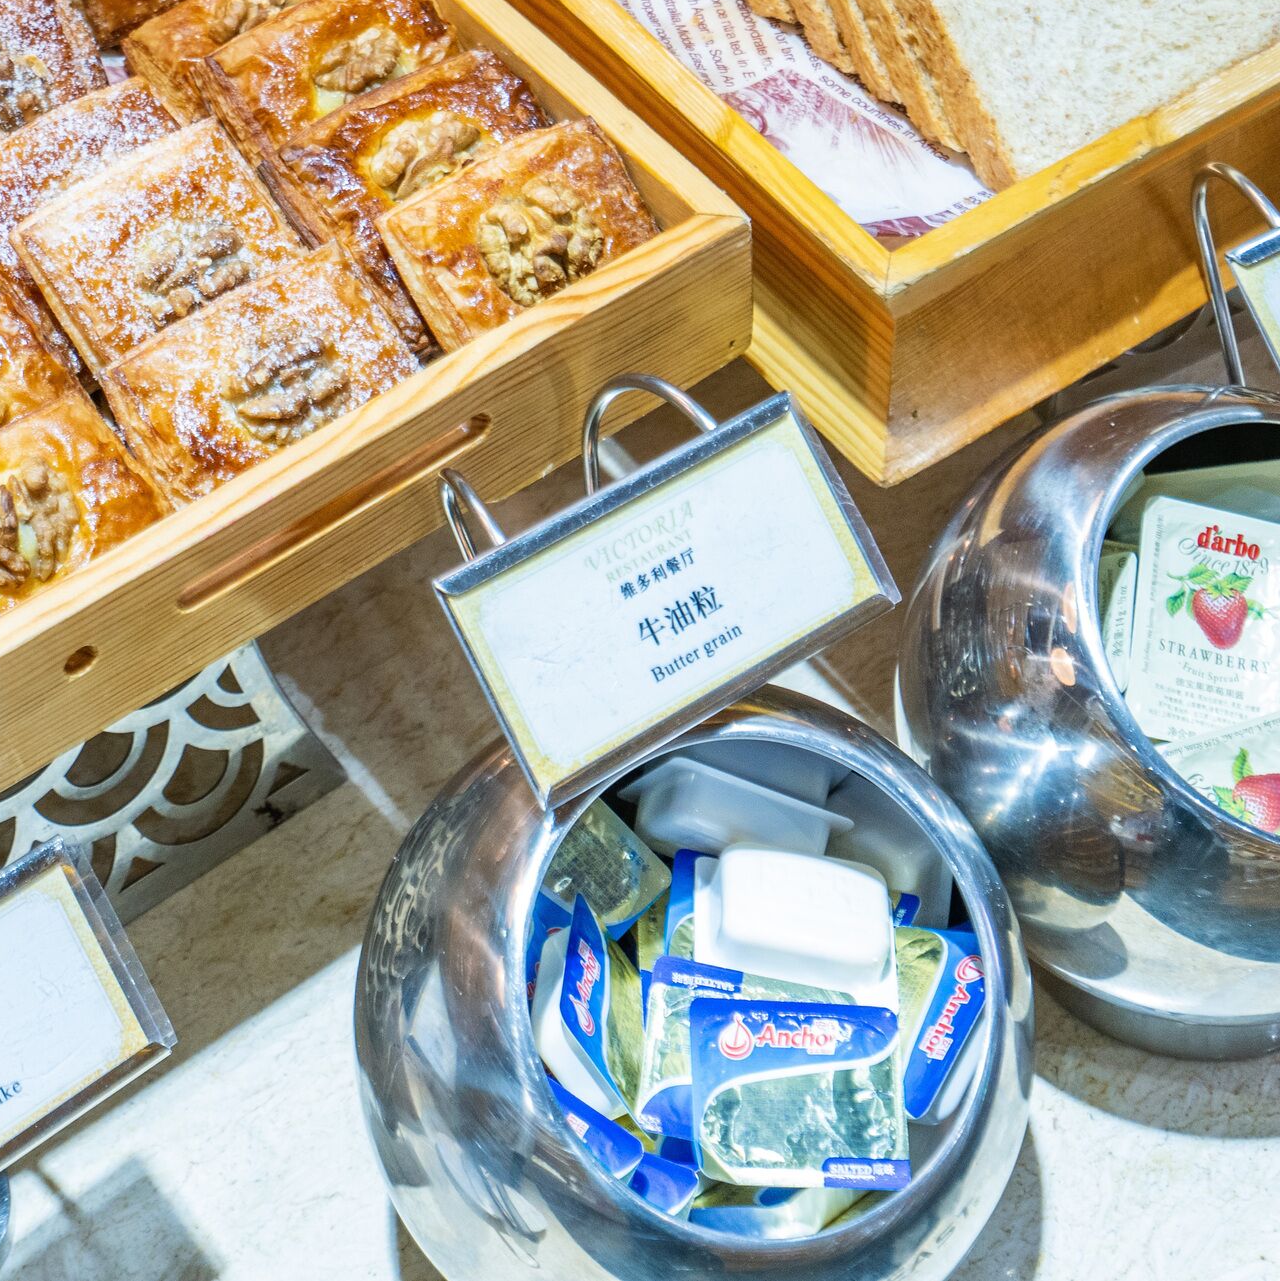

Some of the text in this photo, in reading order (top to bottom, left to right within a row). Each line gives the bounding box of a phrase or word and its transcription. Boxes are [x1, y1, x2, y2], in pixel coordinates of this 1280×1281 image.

[708, 45, 731, 75] South
[820, 74, 852, 99] some
[851, 96, 904, 131] countries
[902, 128, 916, 140] in
[585, 501, 694, 570] VICTORIA
[607, 531, 693, 581] RESTAURANT
[1177, 536, 1271, 582] Since 1879
[621, 548, 693, 599] 维多利餐厅
[639, 587, 722, 645] 牛油粒
[651, 626, 742, 682] Butter grain
[1159, 638, 1270, 676] STRAWBERRY
[1181, 661, 1206, 677] Fruit
[576, 949, 600, 1003] Anchor
[925, 983, 970, 1059] Anchor
[829, 1163, 872, 1175] SALTED
